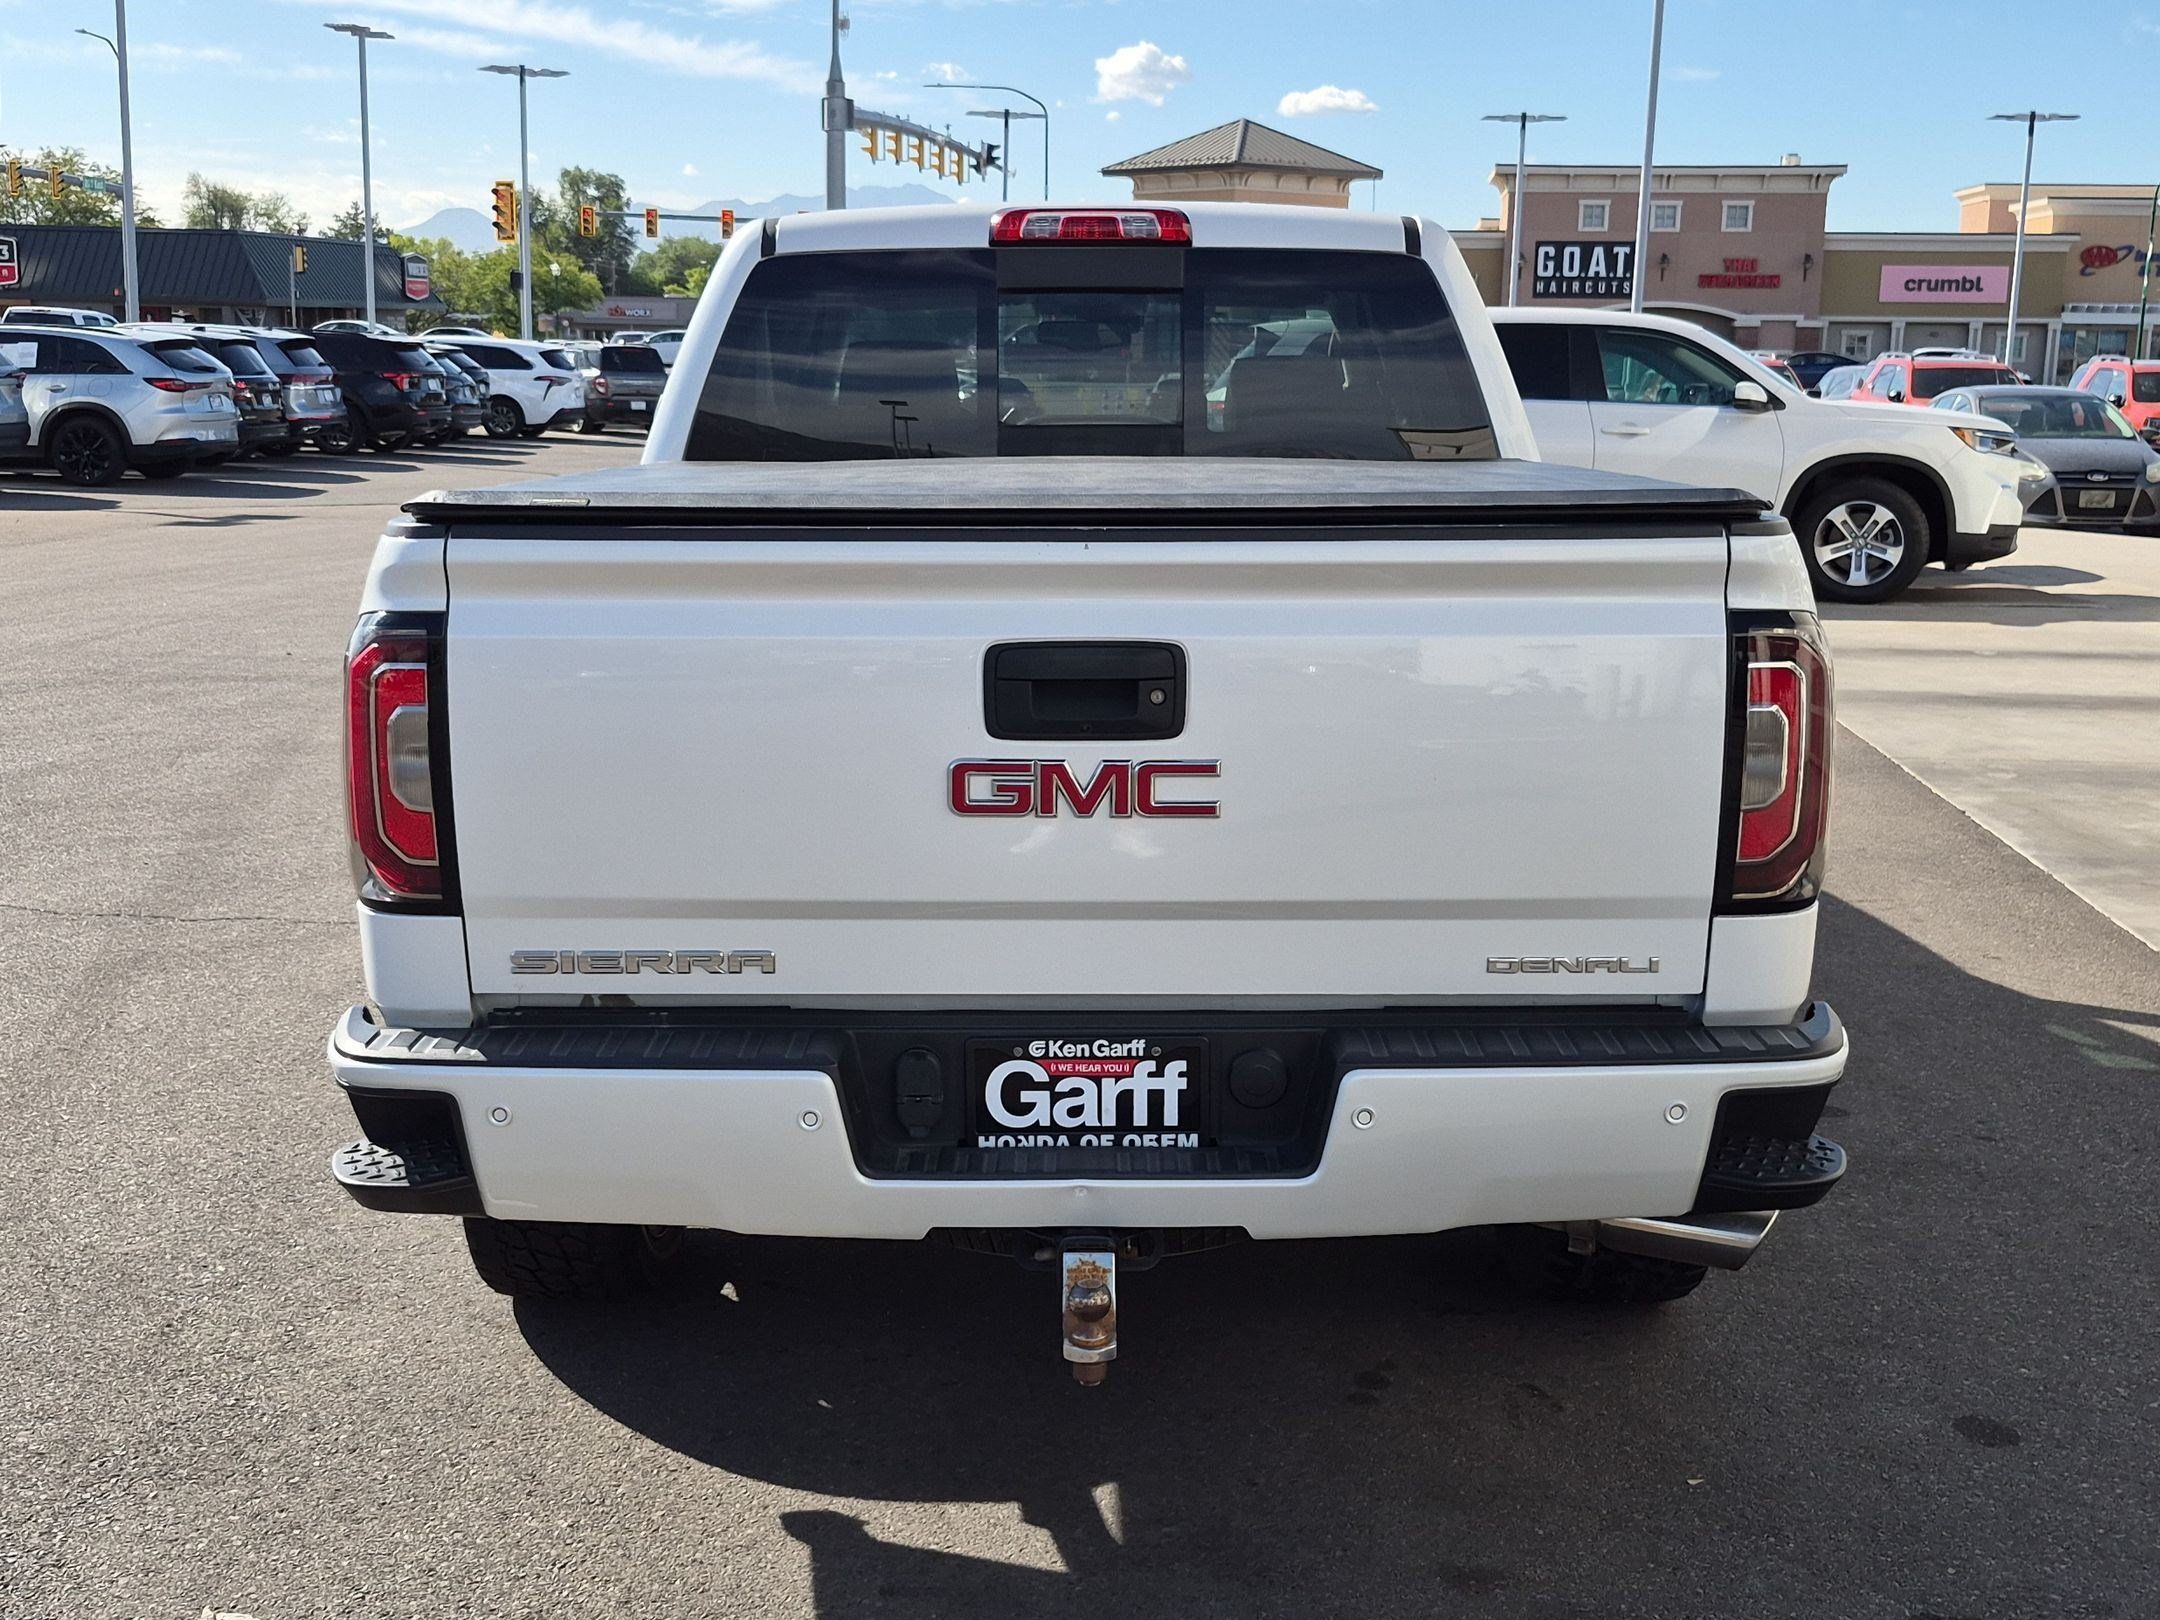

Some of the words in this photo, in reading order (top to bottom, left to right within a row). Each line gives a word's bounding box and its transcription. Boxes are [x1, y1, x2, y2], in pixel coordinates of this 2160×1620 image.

[1536, 246, 1631, 277] G.O.A.T.
[1536, 281, 1630, 294] HAIRCUTS
[1904, 276, 1984, 293] crumbl
[947, 758, 1222, 817] GMC
[510, 949, 776, 975] SIERRA
[1486, 956, 1660, 974] DENALI
[1048, 1039, 1090, 1057] Ken
[1092, 1039, 1146, 1057] Garff
[1057, 1063, 1073, 1073] WE
[1075, 1064, 1101, 1073] HEAR
[1103, 1064, 1122, 1073] YOU
[985, 1060, 1188, 1128] Garff
